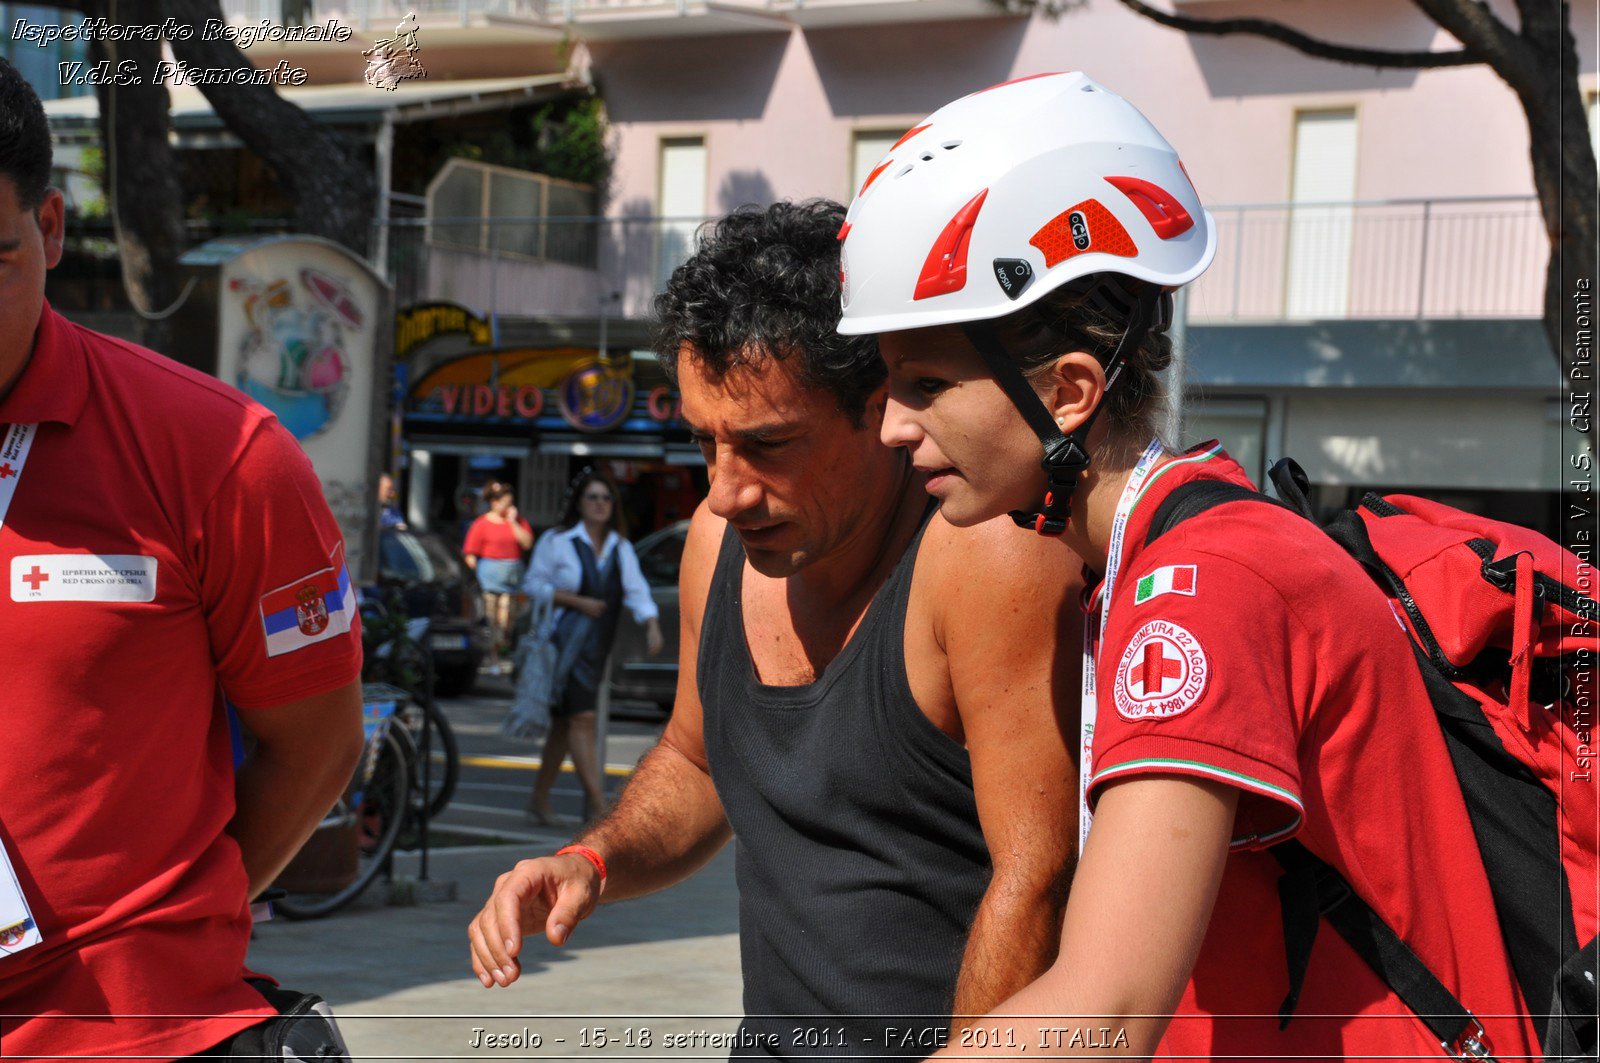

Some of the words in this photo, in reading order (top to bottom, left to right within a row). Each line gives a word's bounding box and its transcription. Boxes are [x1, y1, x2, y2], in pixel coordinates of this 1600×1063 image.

[997, 267, 1013, 291] VISOR
[440, 383, 545, 418] VIDEO
[1132, 622, 1174, 647] GINEVRA
[1175, 632, 1192, 648] 22
[1124, 647, 1134, 659] DI
[1184, 649, 1204, 700] AGOSTO
[1115, 661, 1143, 716] CONVENZIONE
[1160, 697, 1186, 714] 1864
[1083, 723, 1094, 753] FACE
